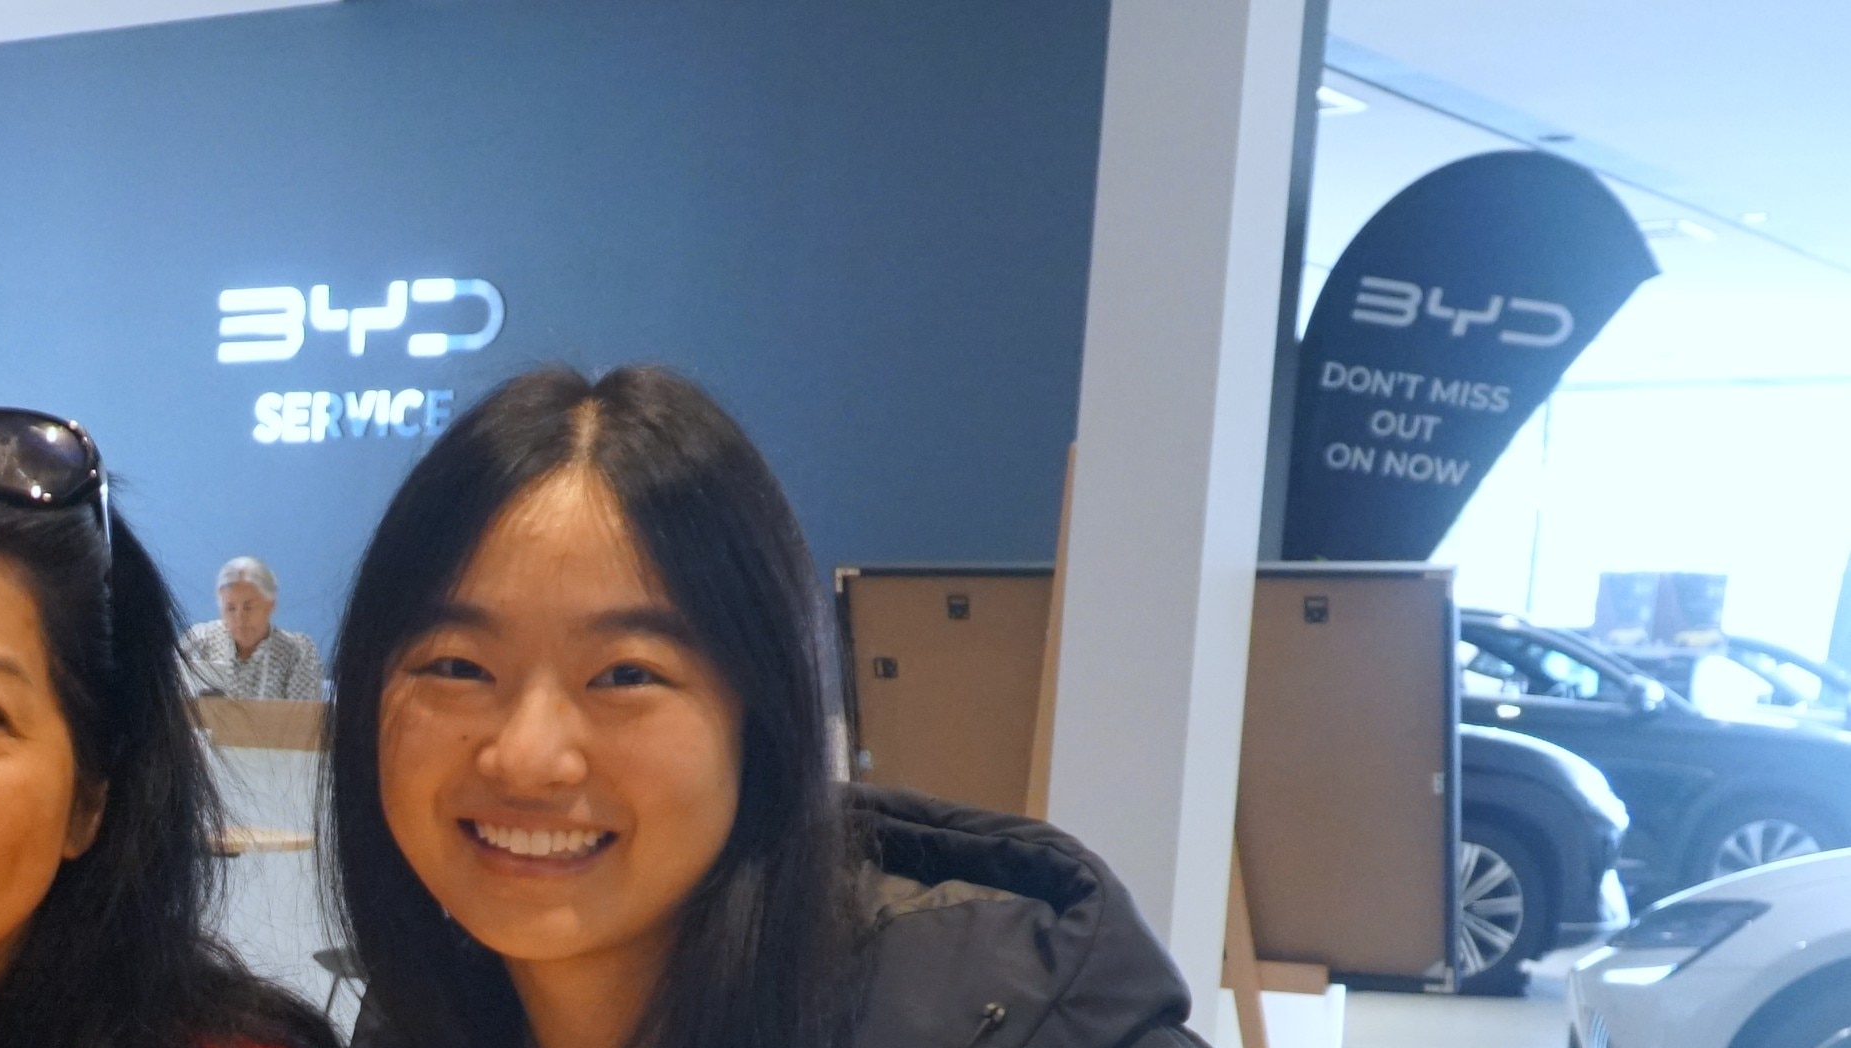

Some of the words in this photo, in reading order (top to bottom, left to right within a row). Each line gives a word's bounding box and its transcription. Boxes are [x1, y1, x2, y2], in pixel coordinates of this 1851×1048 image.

[217, 278, 505, 363] BYD
[1352, 275, 1575, 347] BYD
[1321, 361, 1425, 401] DON'T
[1429, 377, 1511, 413] MISS
[252, 388, 454, 444] SERVICE
[1370, 409, 1441, 442] OUT
[1325, 442, 1375, 474] ON
[1382, 451, 1470, 486] NOW
